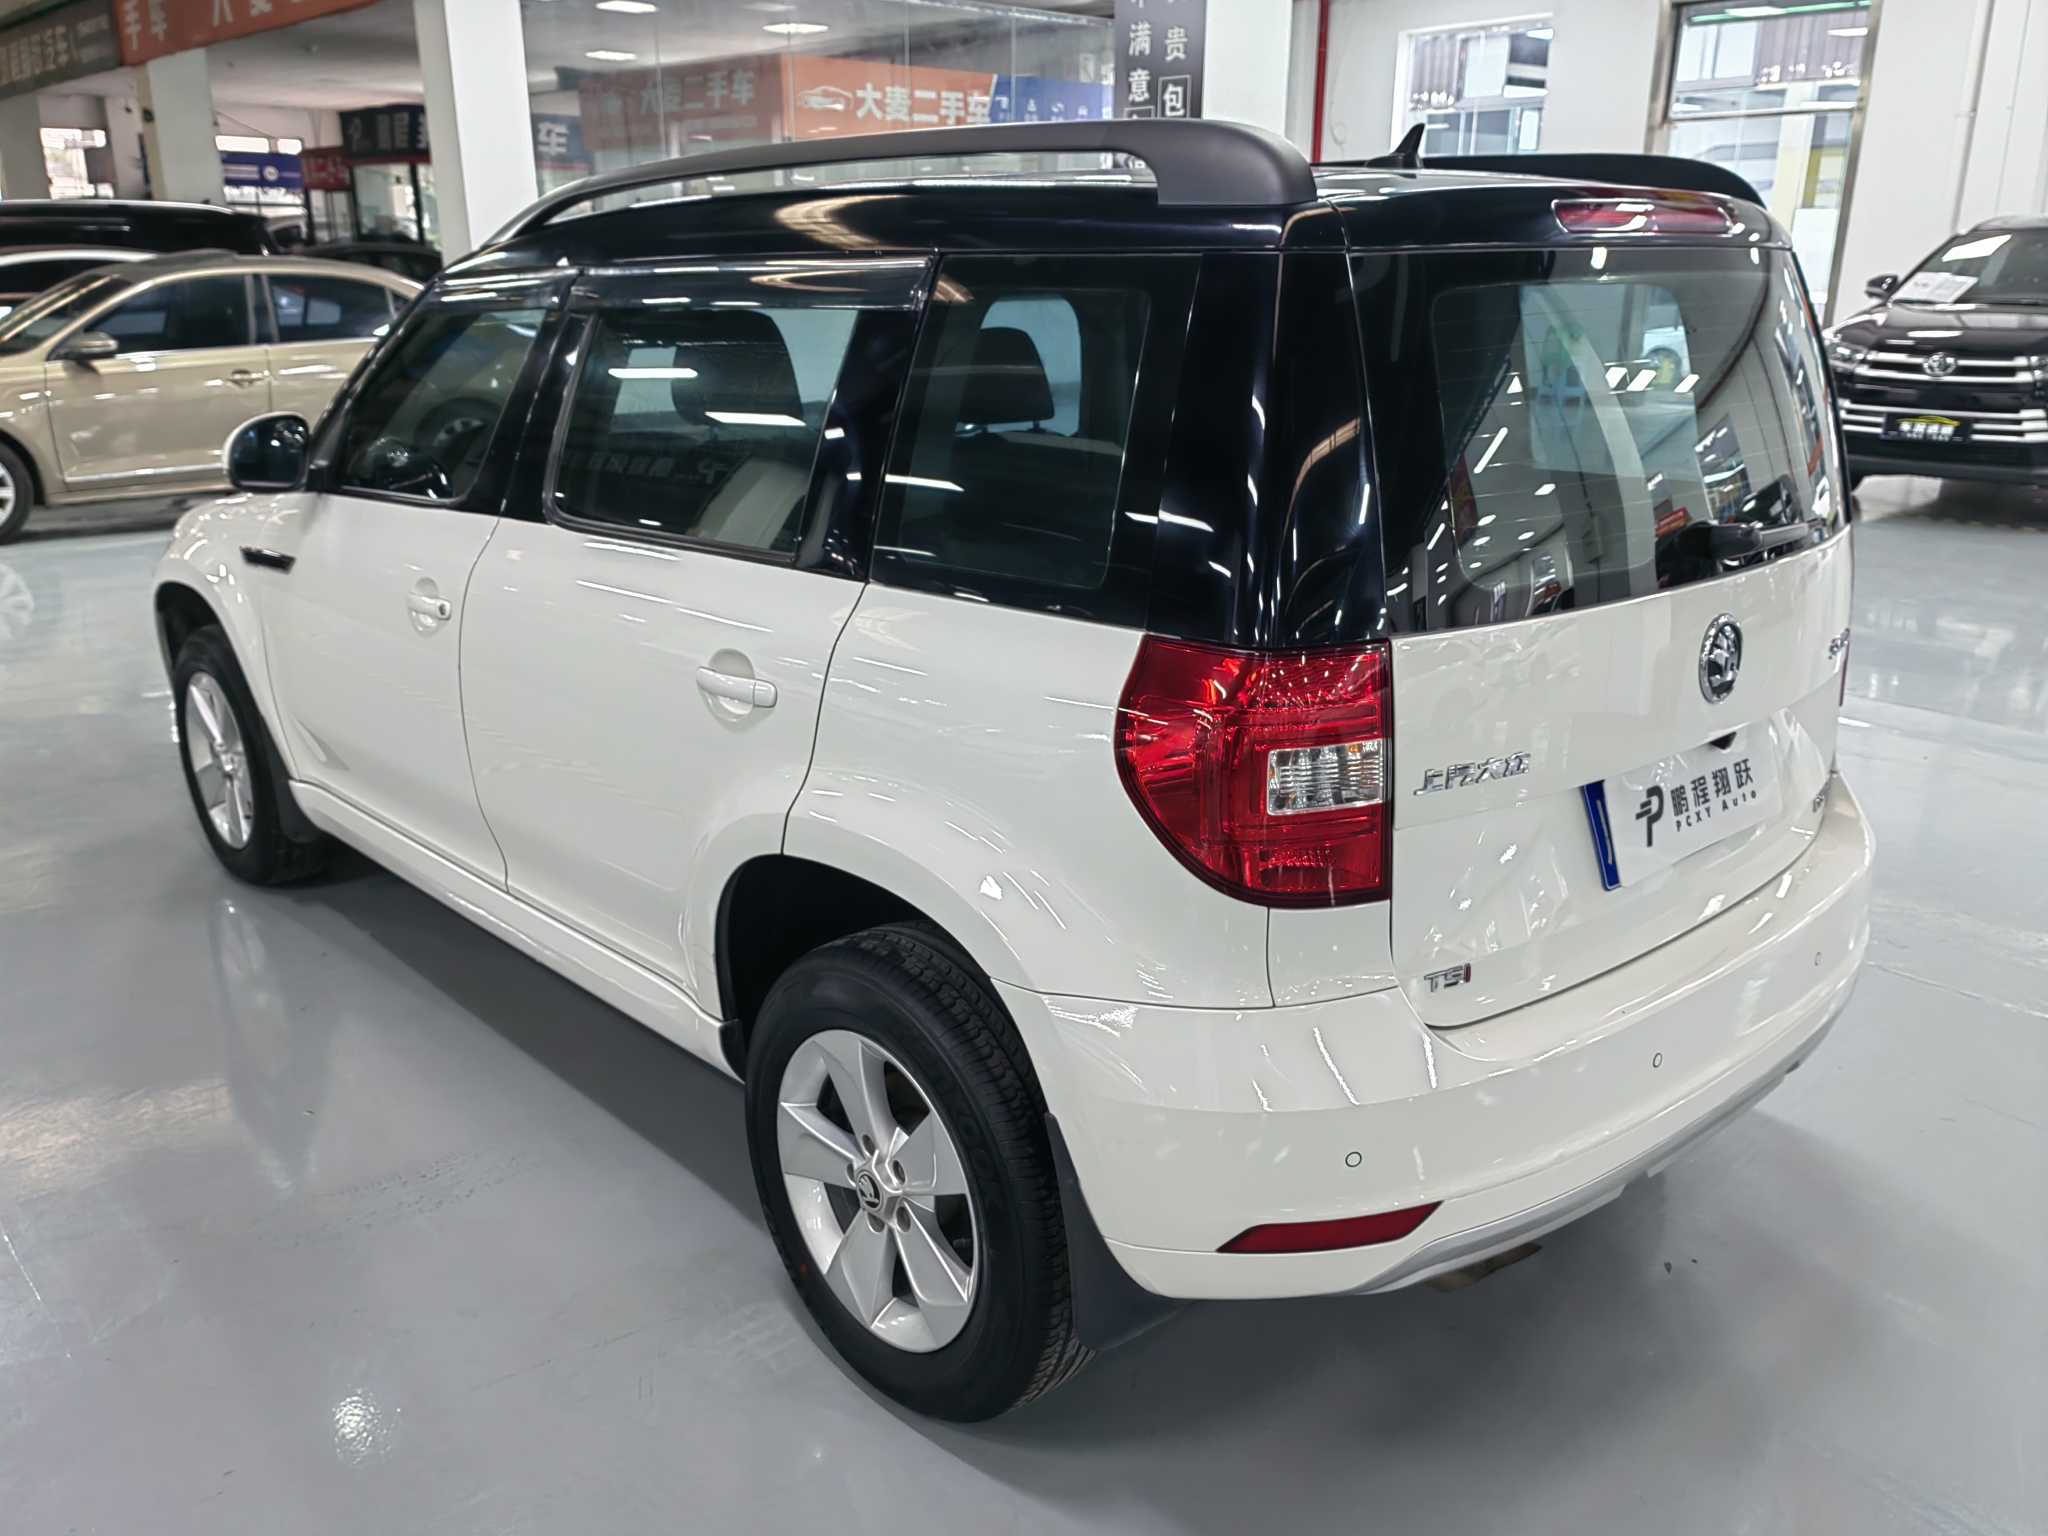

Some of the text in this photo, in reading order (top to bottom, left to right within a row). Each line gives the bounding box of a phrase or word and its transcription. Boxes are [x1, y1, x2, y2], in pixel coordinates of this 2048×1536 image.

[855, 82, 991, 124] 大麦二手车
[1670, 758, 1754, 817] 鹏程翔跃
[1676, 807, 1711, 832] PCXY
